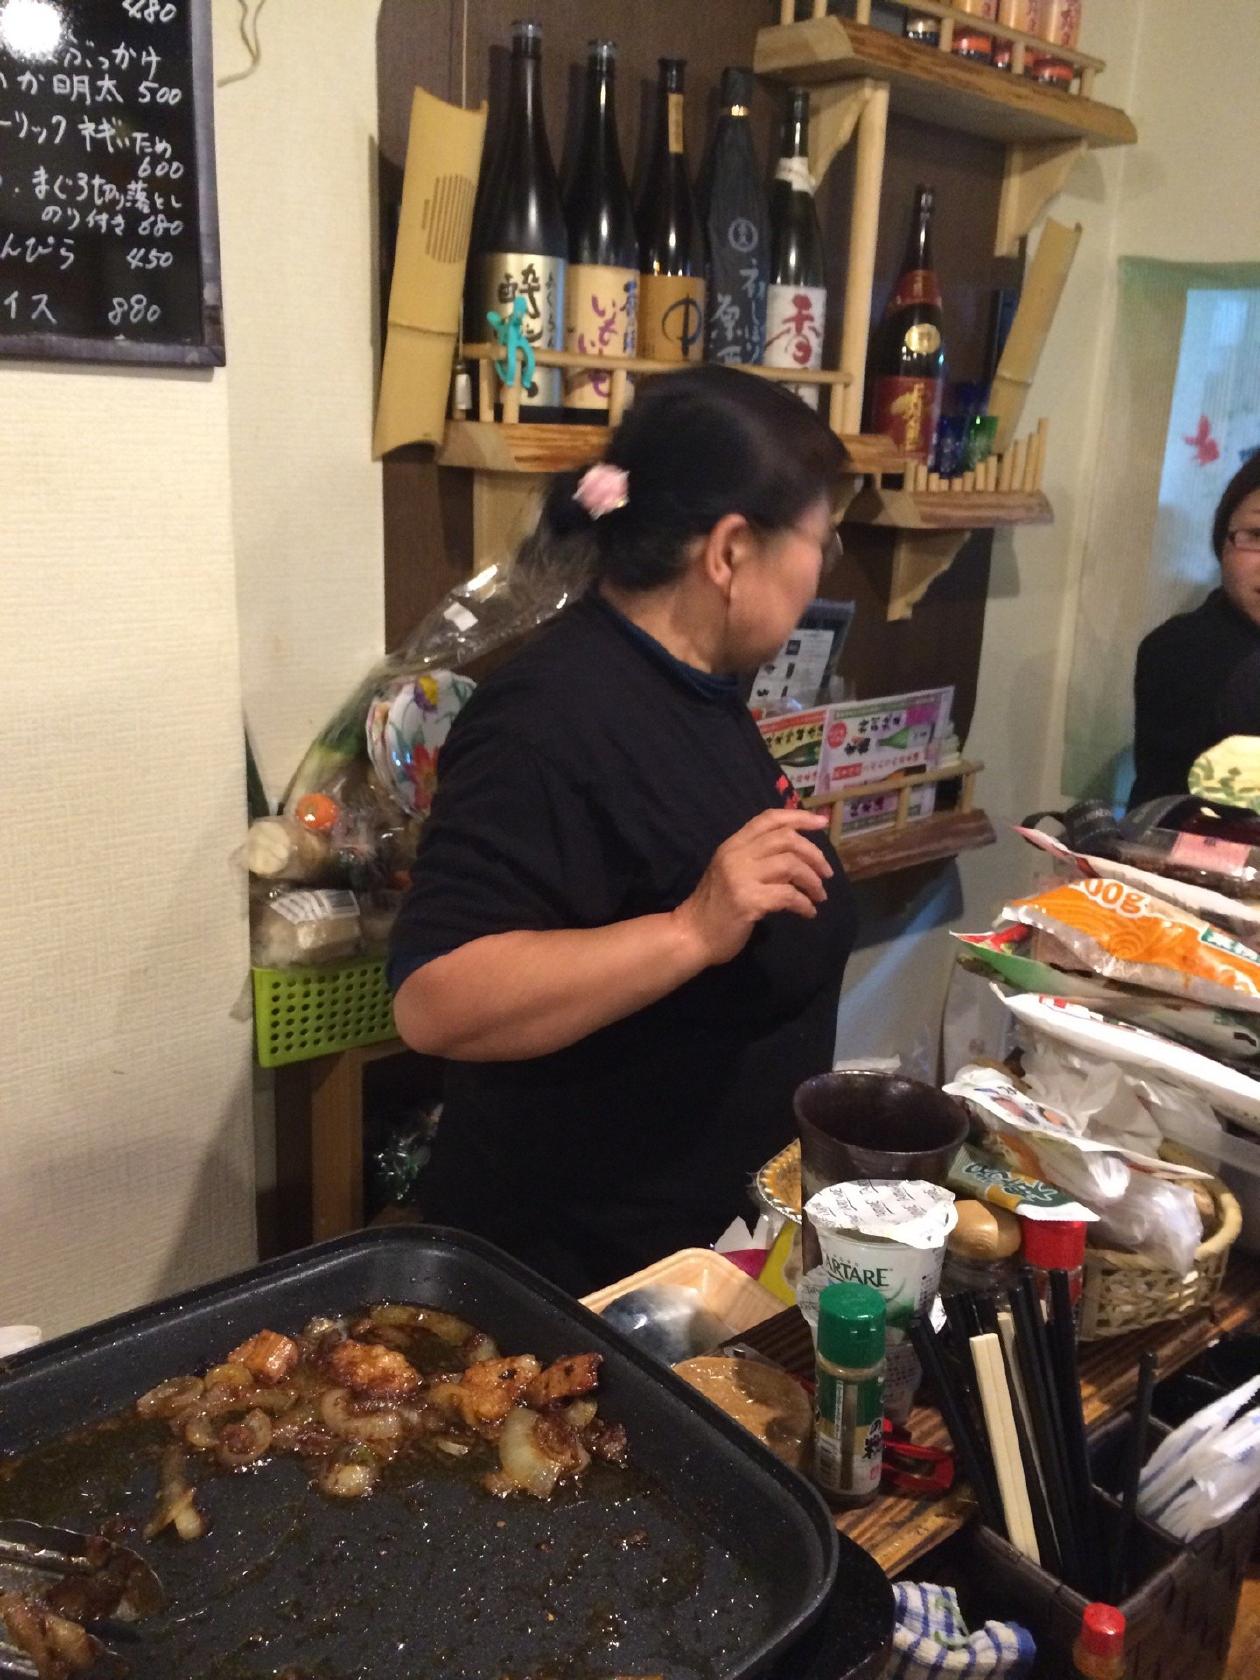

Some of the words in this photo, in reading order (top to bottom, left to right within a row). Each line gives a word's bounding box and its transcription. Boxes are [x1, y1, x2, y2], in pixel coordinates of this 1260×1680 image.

[121, 0, 177, 22] 480
[138, 80, 182, 106] 500
[138, 155, 184, 179] 600
[41, 205, 126, 236] のり付き
[137, 213, 184, 238] 680
[126, 247, 174, 270] 450
[3, 290, 58, 325] イス
[107, 293, 161, 326] 880
